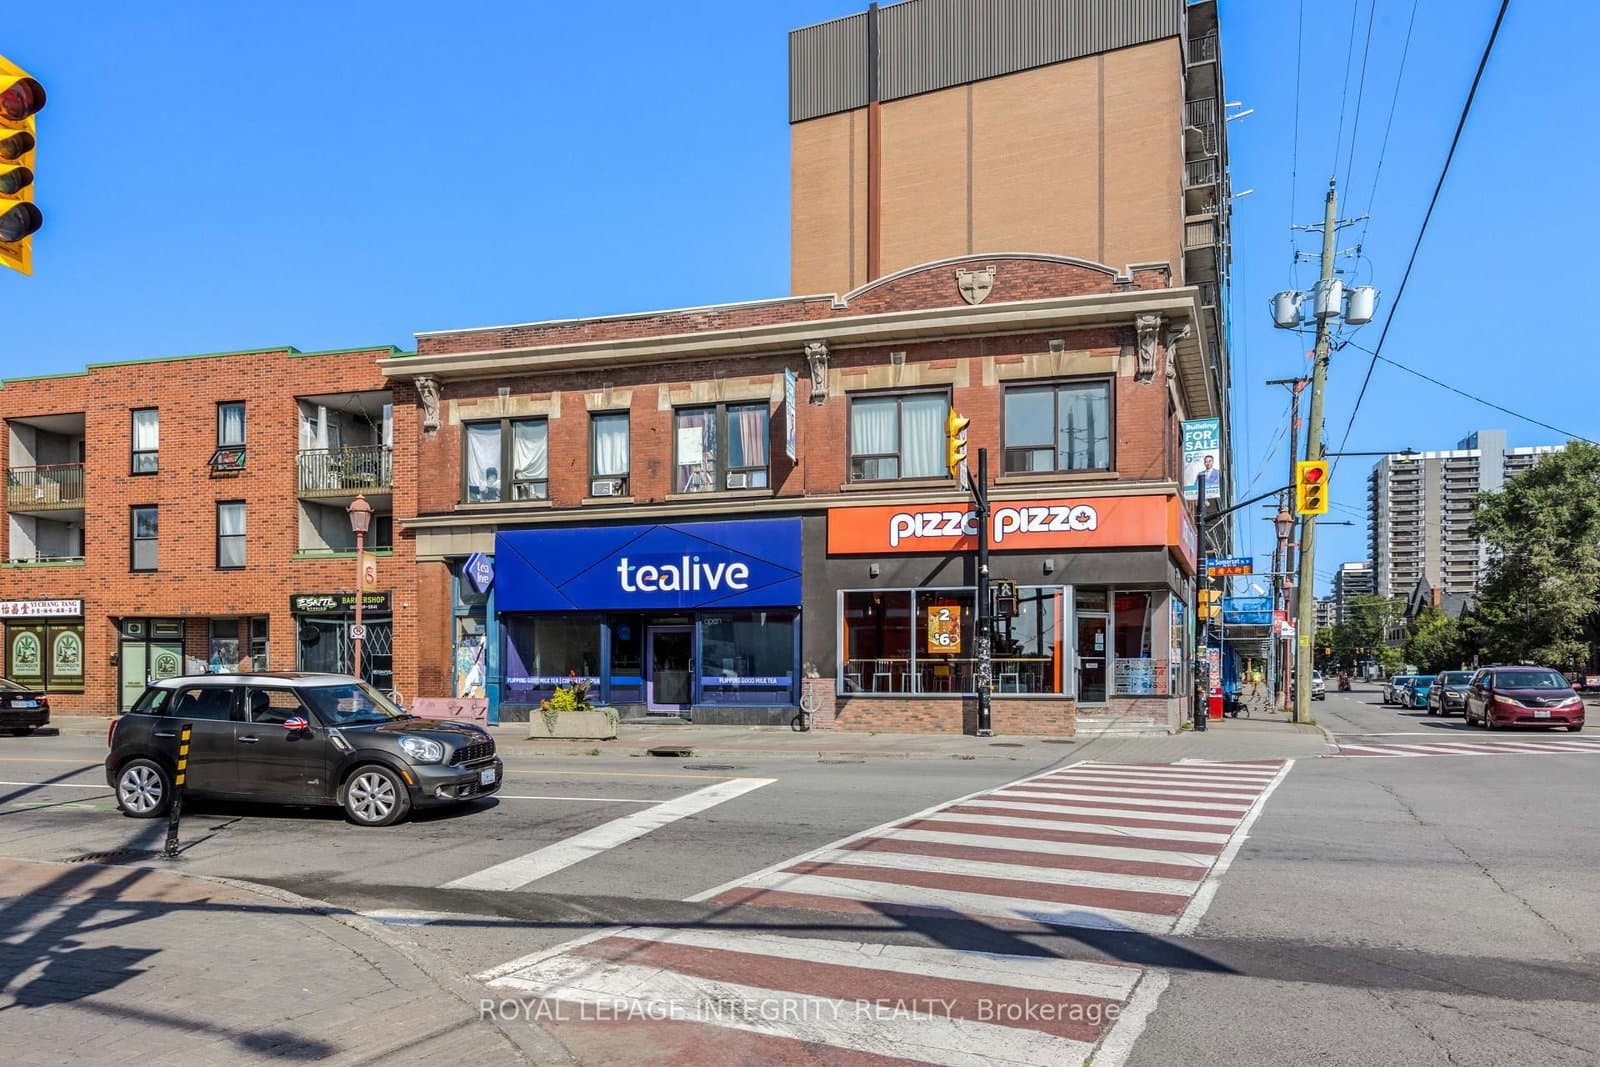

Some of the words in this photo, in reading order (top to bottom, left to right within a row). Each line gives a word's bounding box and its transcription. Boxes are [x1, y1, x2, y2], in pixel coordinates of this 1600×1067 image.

[1185, 430, 1212, 441] FOR
[1185, 439, 1217, 451] SALE
[1185, 453, 1193, 464] 6
[477, 561, 489, 573] tea
[477, 572, 489, 584] live
[617, 556, 749, 592] tealive
[939, 608, 950, 621] 2
